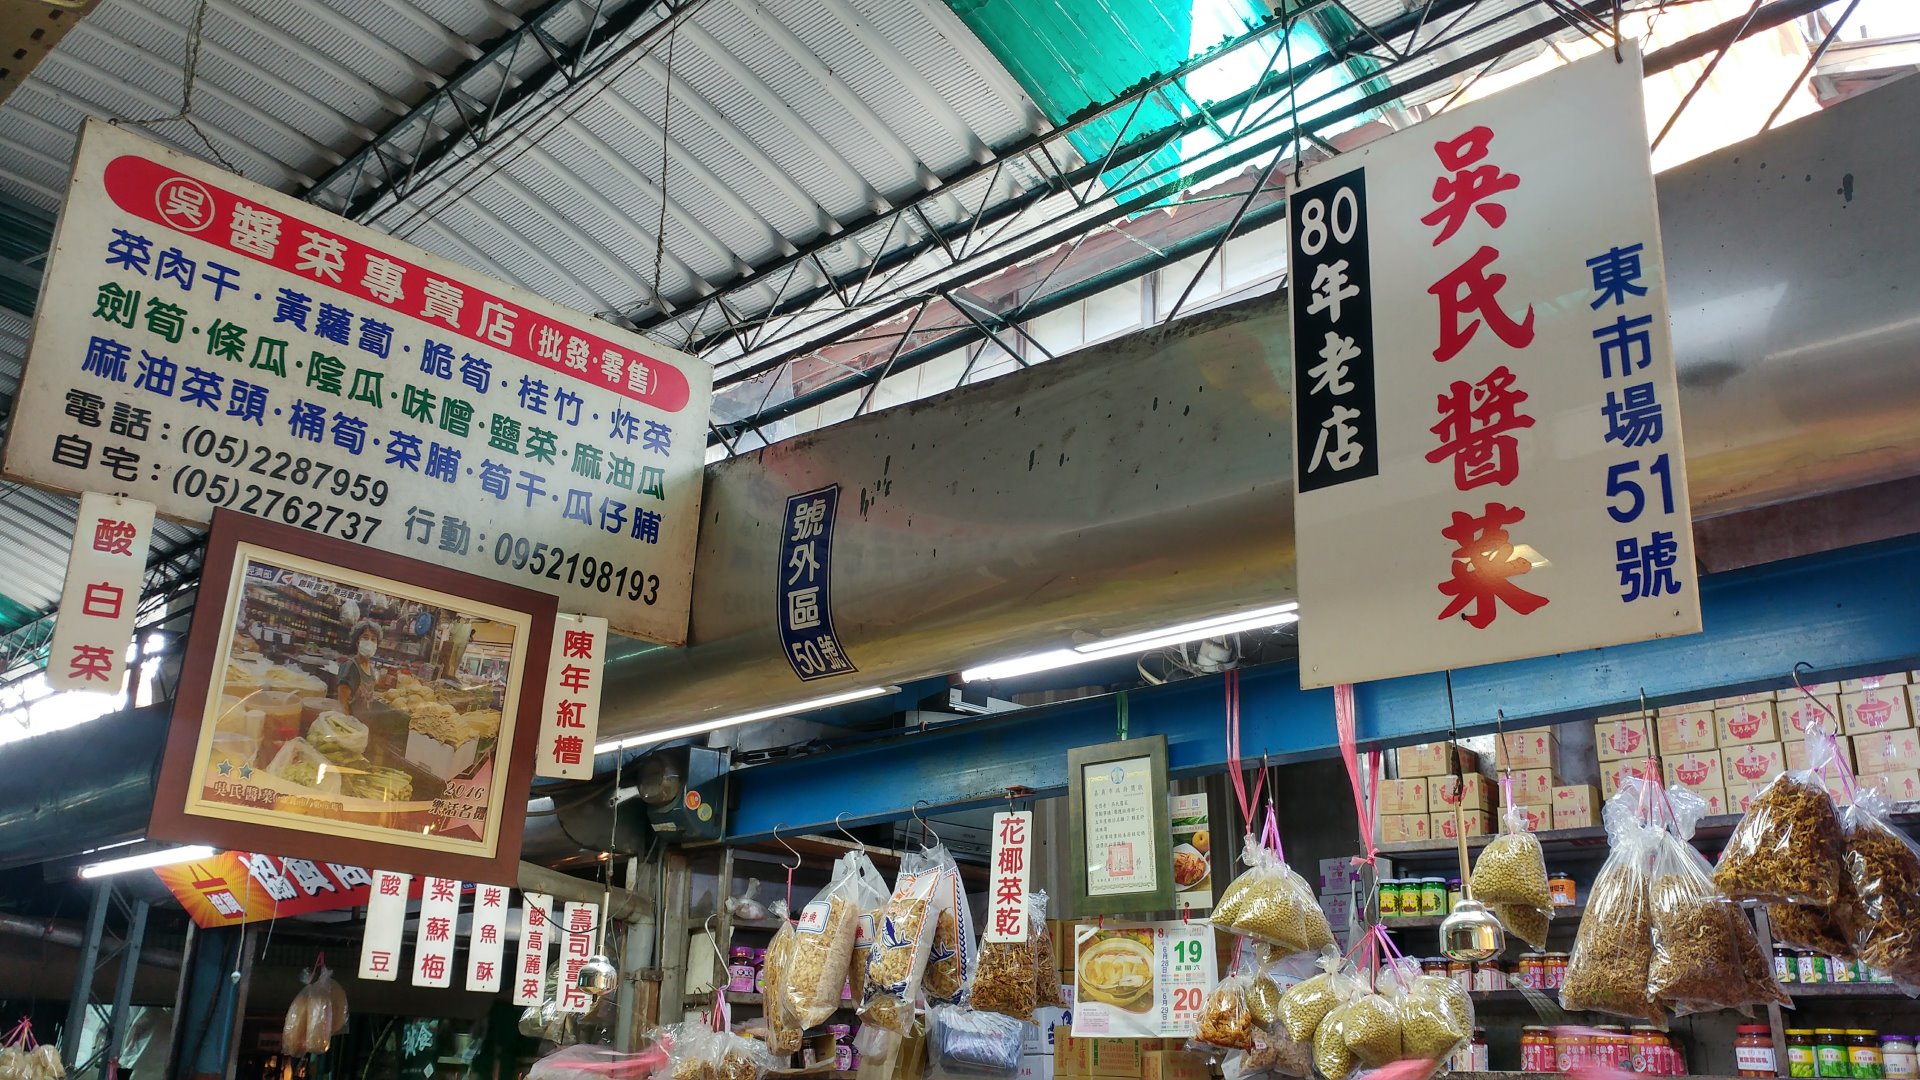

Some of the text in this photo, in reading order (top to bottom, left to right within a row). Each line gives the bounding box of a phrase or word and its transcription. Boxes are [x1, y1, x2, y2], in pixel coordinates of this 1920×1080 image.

[165, 186, 204, 226] 吳
[229, 201, 520, 348] 醬菜專賣店
[1301, 185, 1364, 474] 80年老店
[1419, 125, 1550, 629] 吳氏醬菜
[1585, 242, 1683, 603] 東市場51號
[68, 518, 137, 682] 酸白菜
[788, 499, 826, 631] 號外區
[552, 629, 595, 766] 陳年紅槽
[791, 634, 848, 675] 50號
[444, 780, 485, 799] 2016
[369, 874, 402, 973] 酸豆
[421, 877, 456, 980] 紫蘇梅
[995, 817, 1026, 937] 花椰菜乾
[476, 887, 502, 982] 柴魚酥
[521, 906, 546, 999] 酸高麗菜
[1174, 940, 1203, 964] 19
[1173, 987, 1203, 1011] 20
